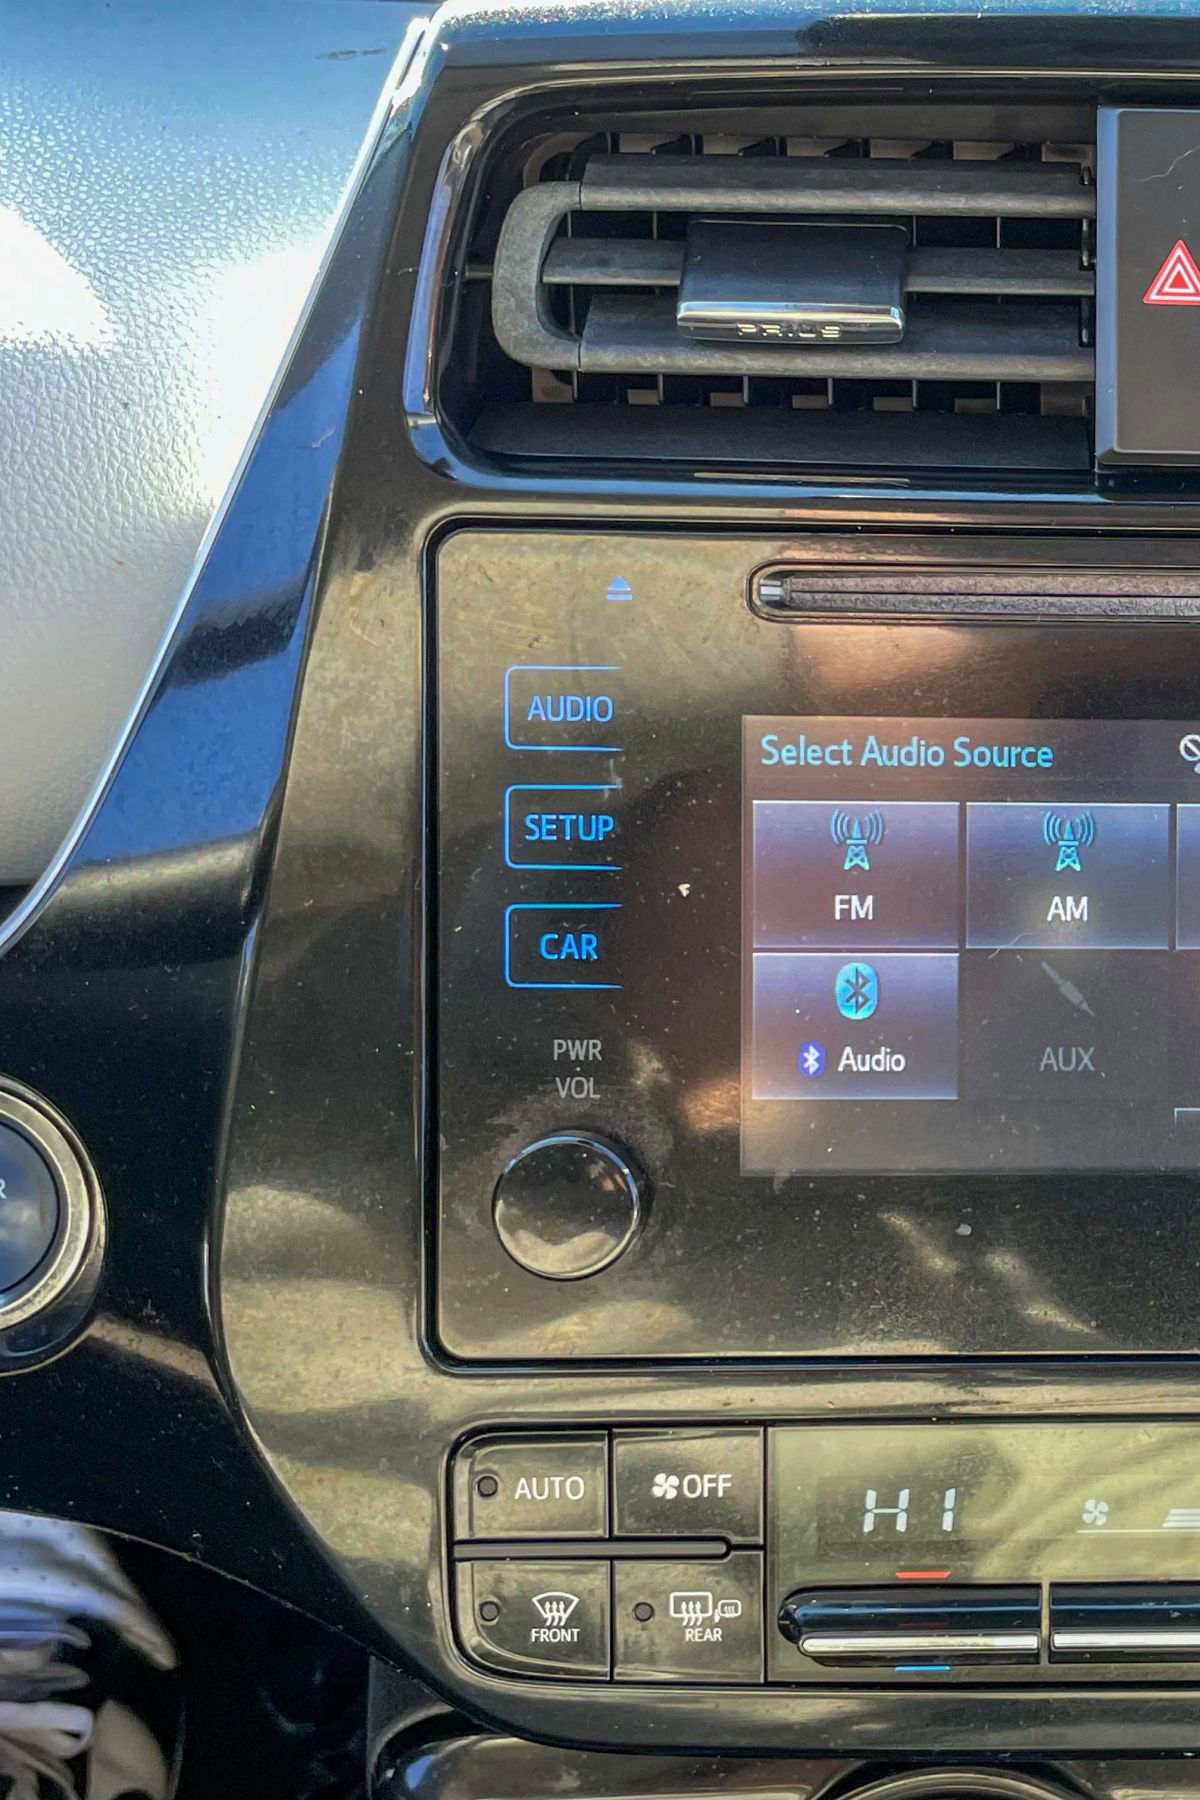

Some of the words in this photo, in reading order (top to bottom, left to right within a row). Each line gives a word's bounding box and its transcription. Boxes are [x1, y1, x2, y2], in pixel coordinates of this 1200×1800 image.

[526, 695, 614, 723] AUDIO
[760, 734, 853, 767] Select
[860, 736, 945, 768] Audio
[953, 737, 1054, 768] Source
[523, 814, 616, 842] SETUP
[833, 894, 874, 921] FM
[1046, 896, 1089, 922] AM
[538, 933, 599, 961] CAR
[551, 1039, 603, 1062] PWR
[837, 1046, 906, 1073] Audio
[1038, 1046, 1096, 1073] AUX
[554, 1076, 602, 1100] VOL
[514, 1476, 586, 1501] AUTO
[681, 1473, 733, 1498] OFF
[530, 1627, 580, 1643] FRONT
[684, 1627, 723, 1643] REAR
